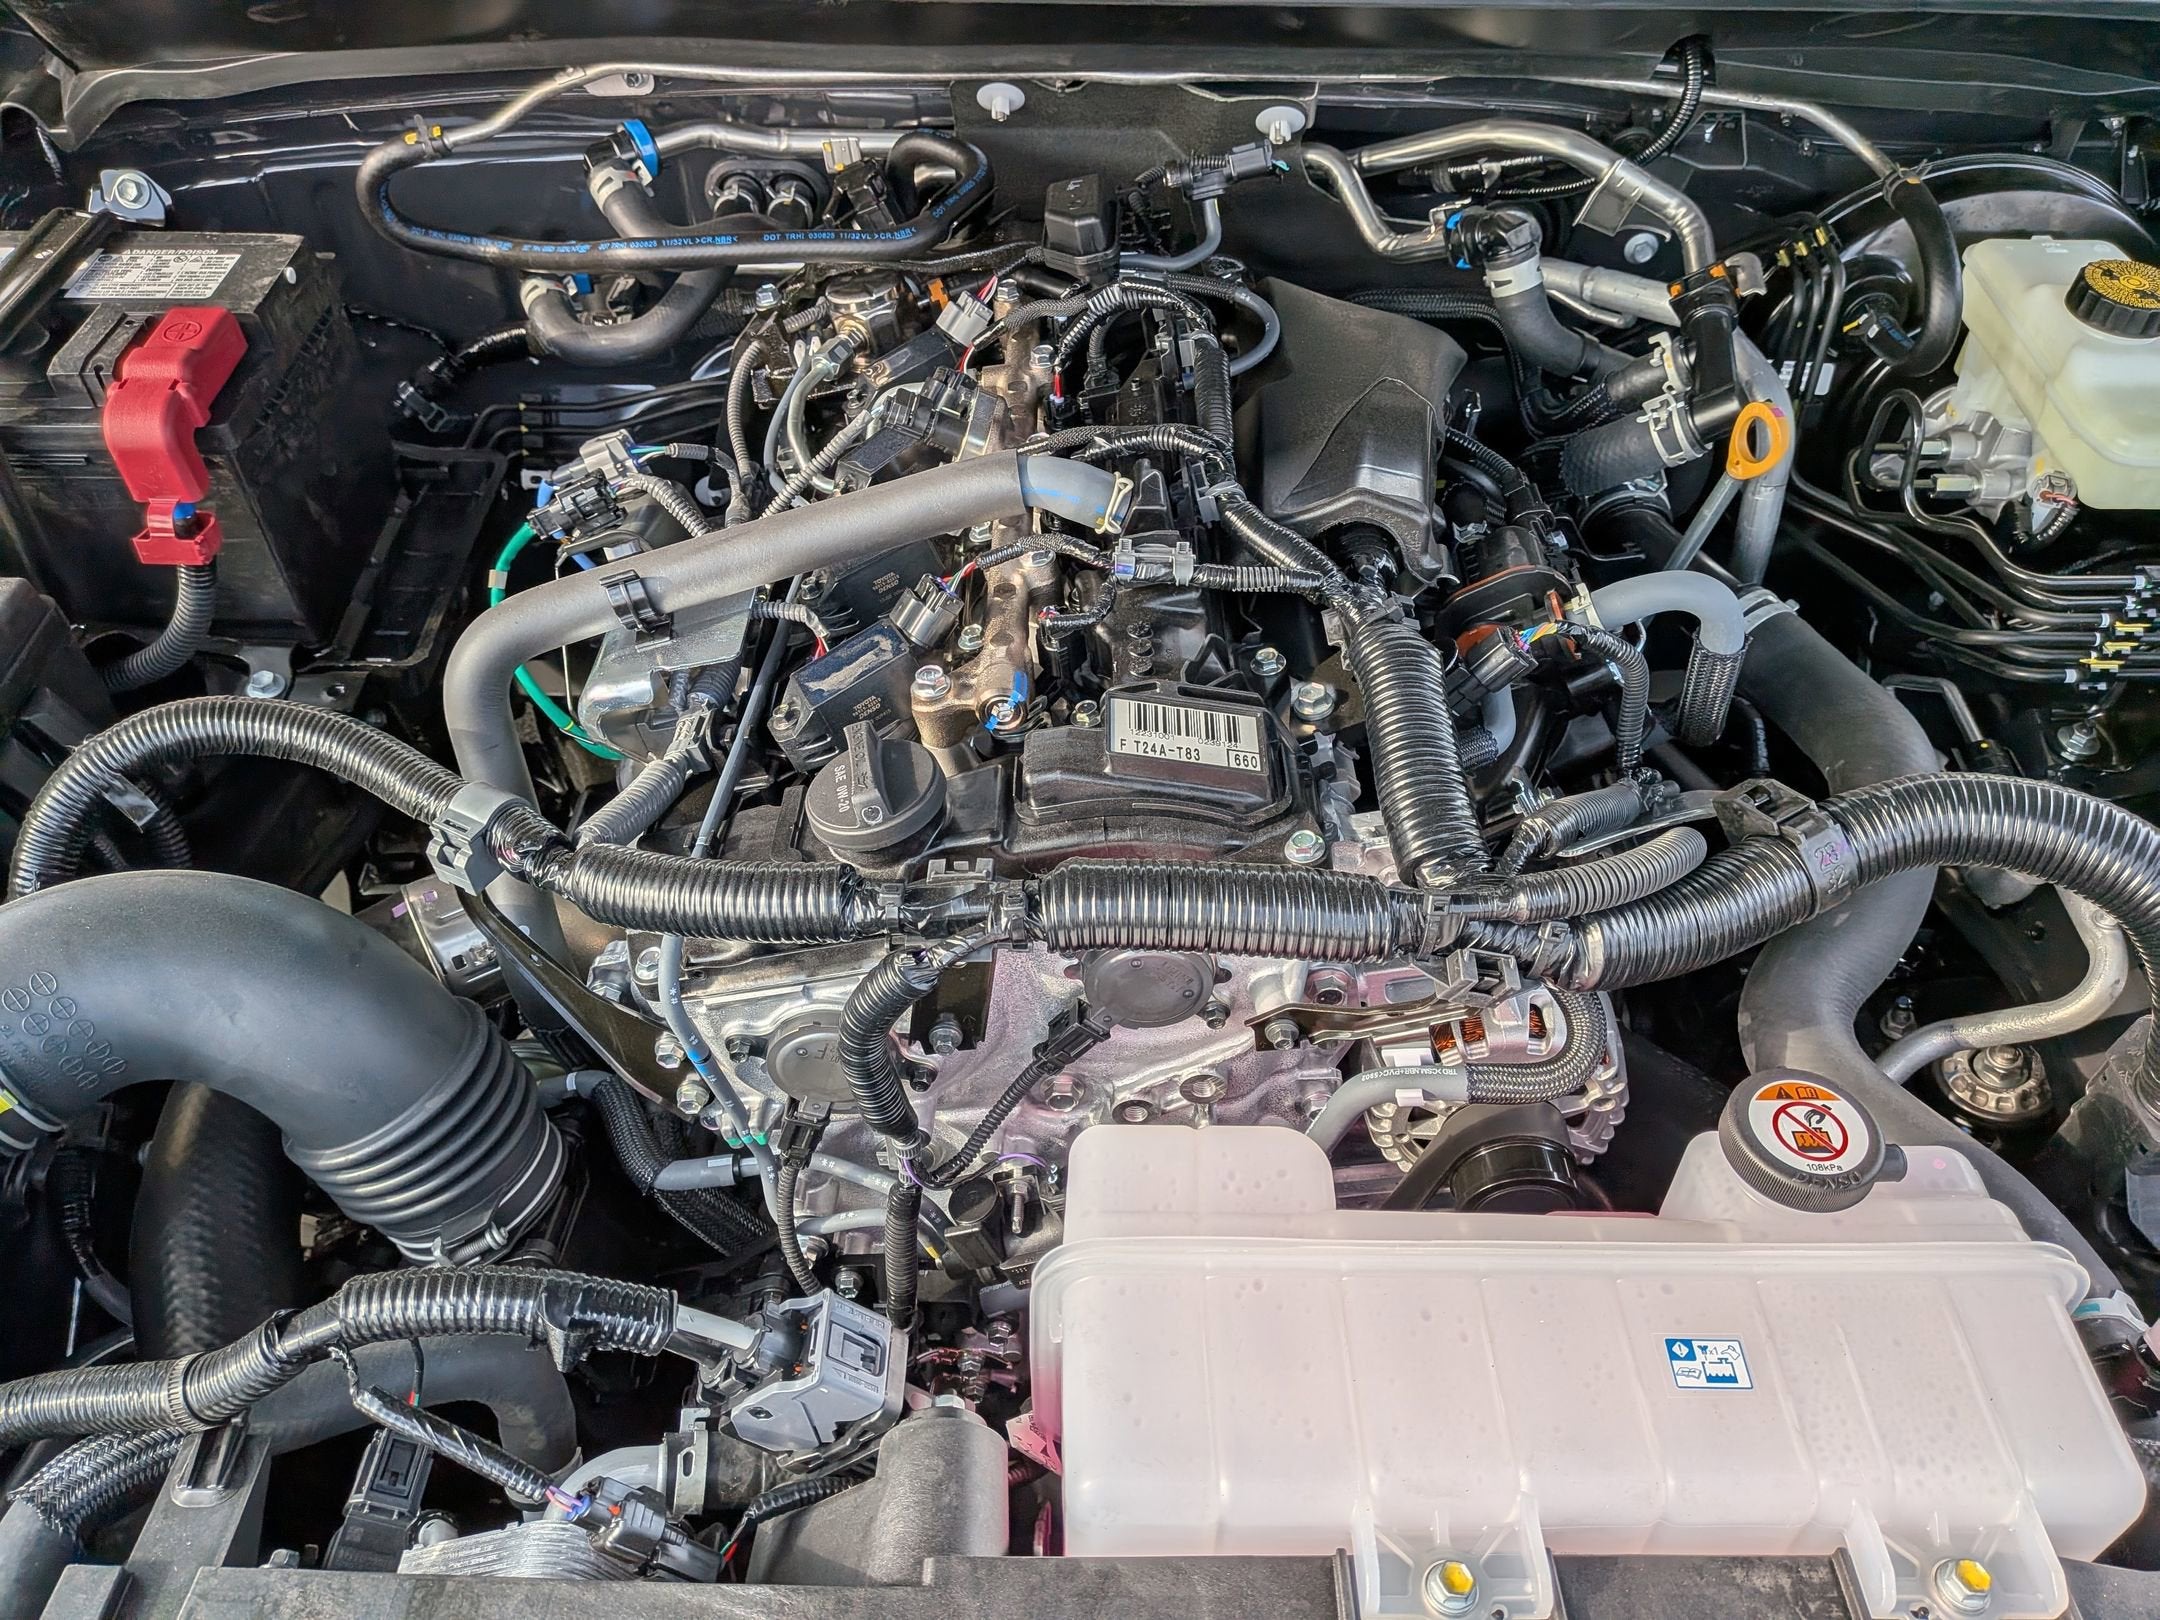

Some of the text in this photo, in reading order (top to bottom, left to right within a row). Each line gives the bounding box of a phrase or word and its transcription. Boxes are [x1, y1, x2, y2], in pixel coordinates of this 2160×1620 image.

[873, 571, 896, 585] TOYOTA
[878, 580, 899, 594] DENSO
[853, 695, 877, 710] TOYOTA
[859, 703, 881, 720] DENSO
[1129, 729, 1175, 741] 12231001
[1120, 738, 1201, 761] F T24A-T83
[1198, 738, 1239, 749] 0239124
[1234, 754, 1258, 769] 660
[834, 765, 850, 813] SAE 0W-20
[1806, 1163, 1843, 1171] 108kPa
[1792, 1171, 1863, 1190] DENSO
